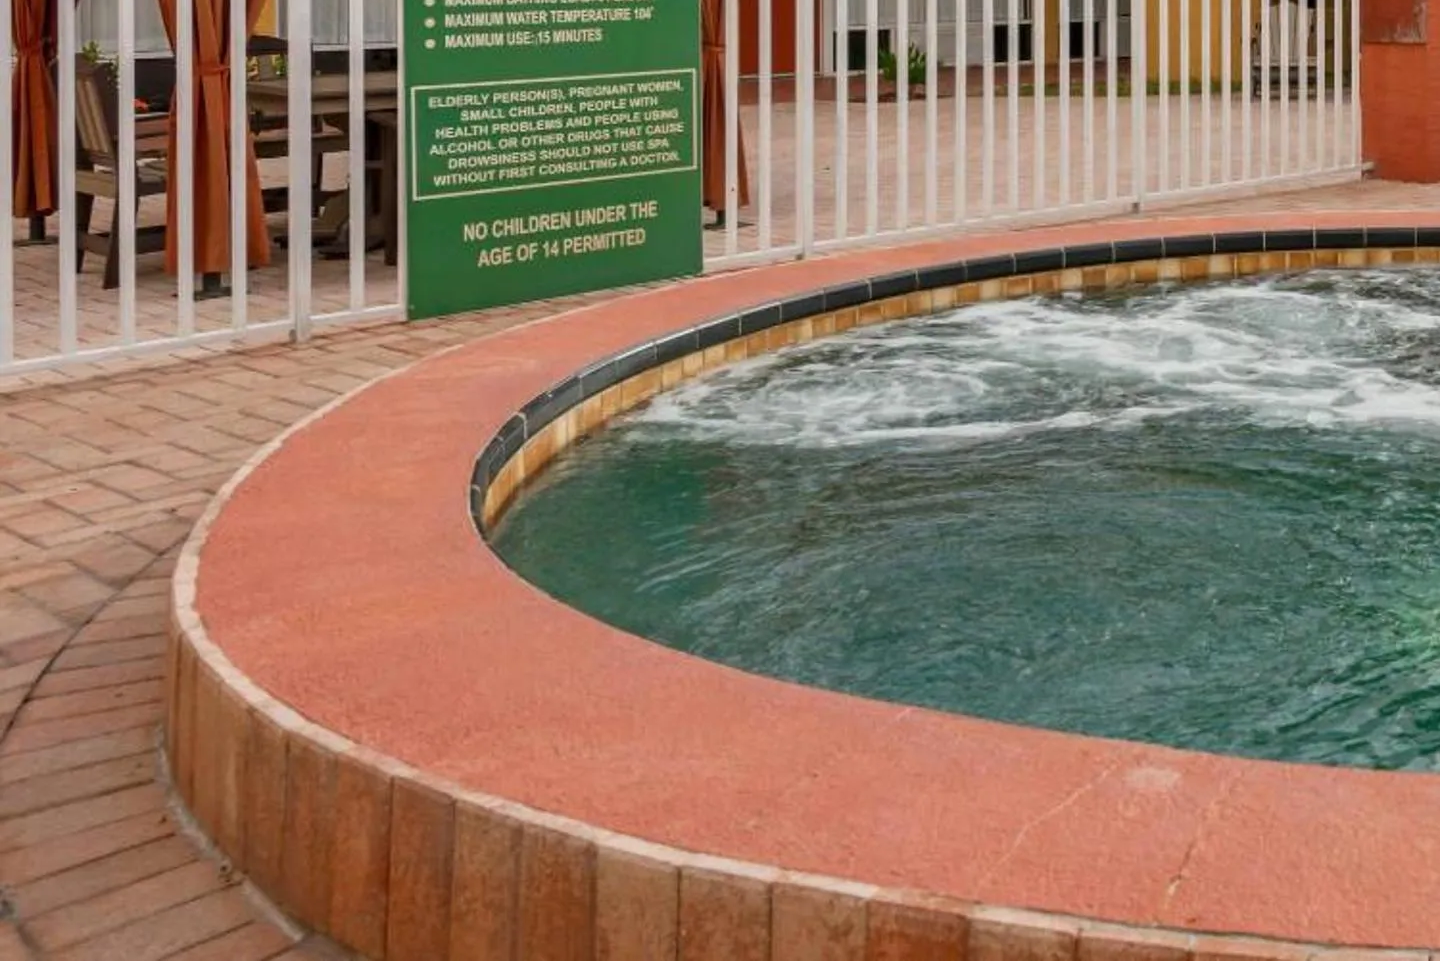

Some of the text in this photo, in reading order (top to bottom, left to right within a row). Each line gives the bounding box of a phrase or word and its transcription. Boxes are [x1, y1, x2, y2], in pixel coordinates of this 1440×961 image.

[445, 12, 504, 27] MAXIMUM
[506, 10, 548, 25] WATER
[550, 8, 631, 23] TEMPERATURE
[445, 33, 504, 48] MAXIMUM
[538, 31, 551, 44] 15
[553, 28, 602, 43] MINUTES
[428, 94, 490, 108] ELDERLY
[569, 83, 635, 98] PREGNANT
[460, 108, 505, 121] SMALL
[580, 98, 627, 112] PEOPLE
[629, 96, 658, 108] WITH
[435, 108, 678, 139] HEALTH PROBLEMS AND PEOPLE USING
[429, 122, 685, 156] ALCOHOL OR OTHER DRUGS THAT CAUSE
[448, 137, 670, 169] DROWSINESS SHOULD NOT USE SPA
[433, 169, 496, 186] WITHOUT
[498, 165, 536, 179] FIRST
[539, 158, 617, 175] CONSULTING
[619, 156, 628, 167] A
[463, 200, 658, 242] NO CHILDREN UNDER THE
[477, 228, 646, 267] AGE OF 14 PERMITTED
